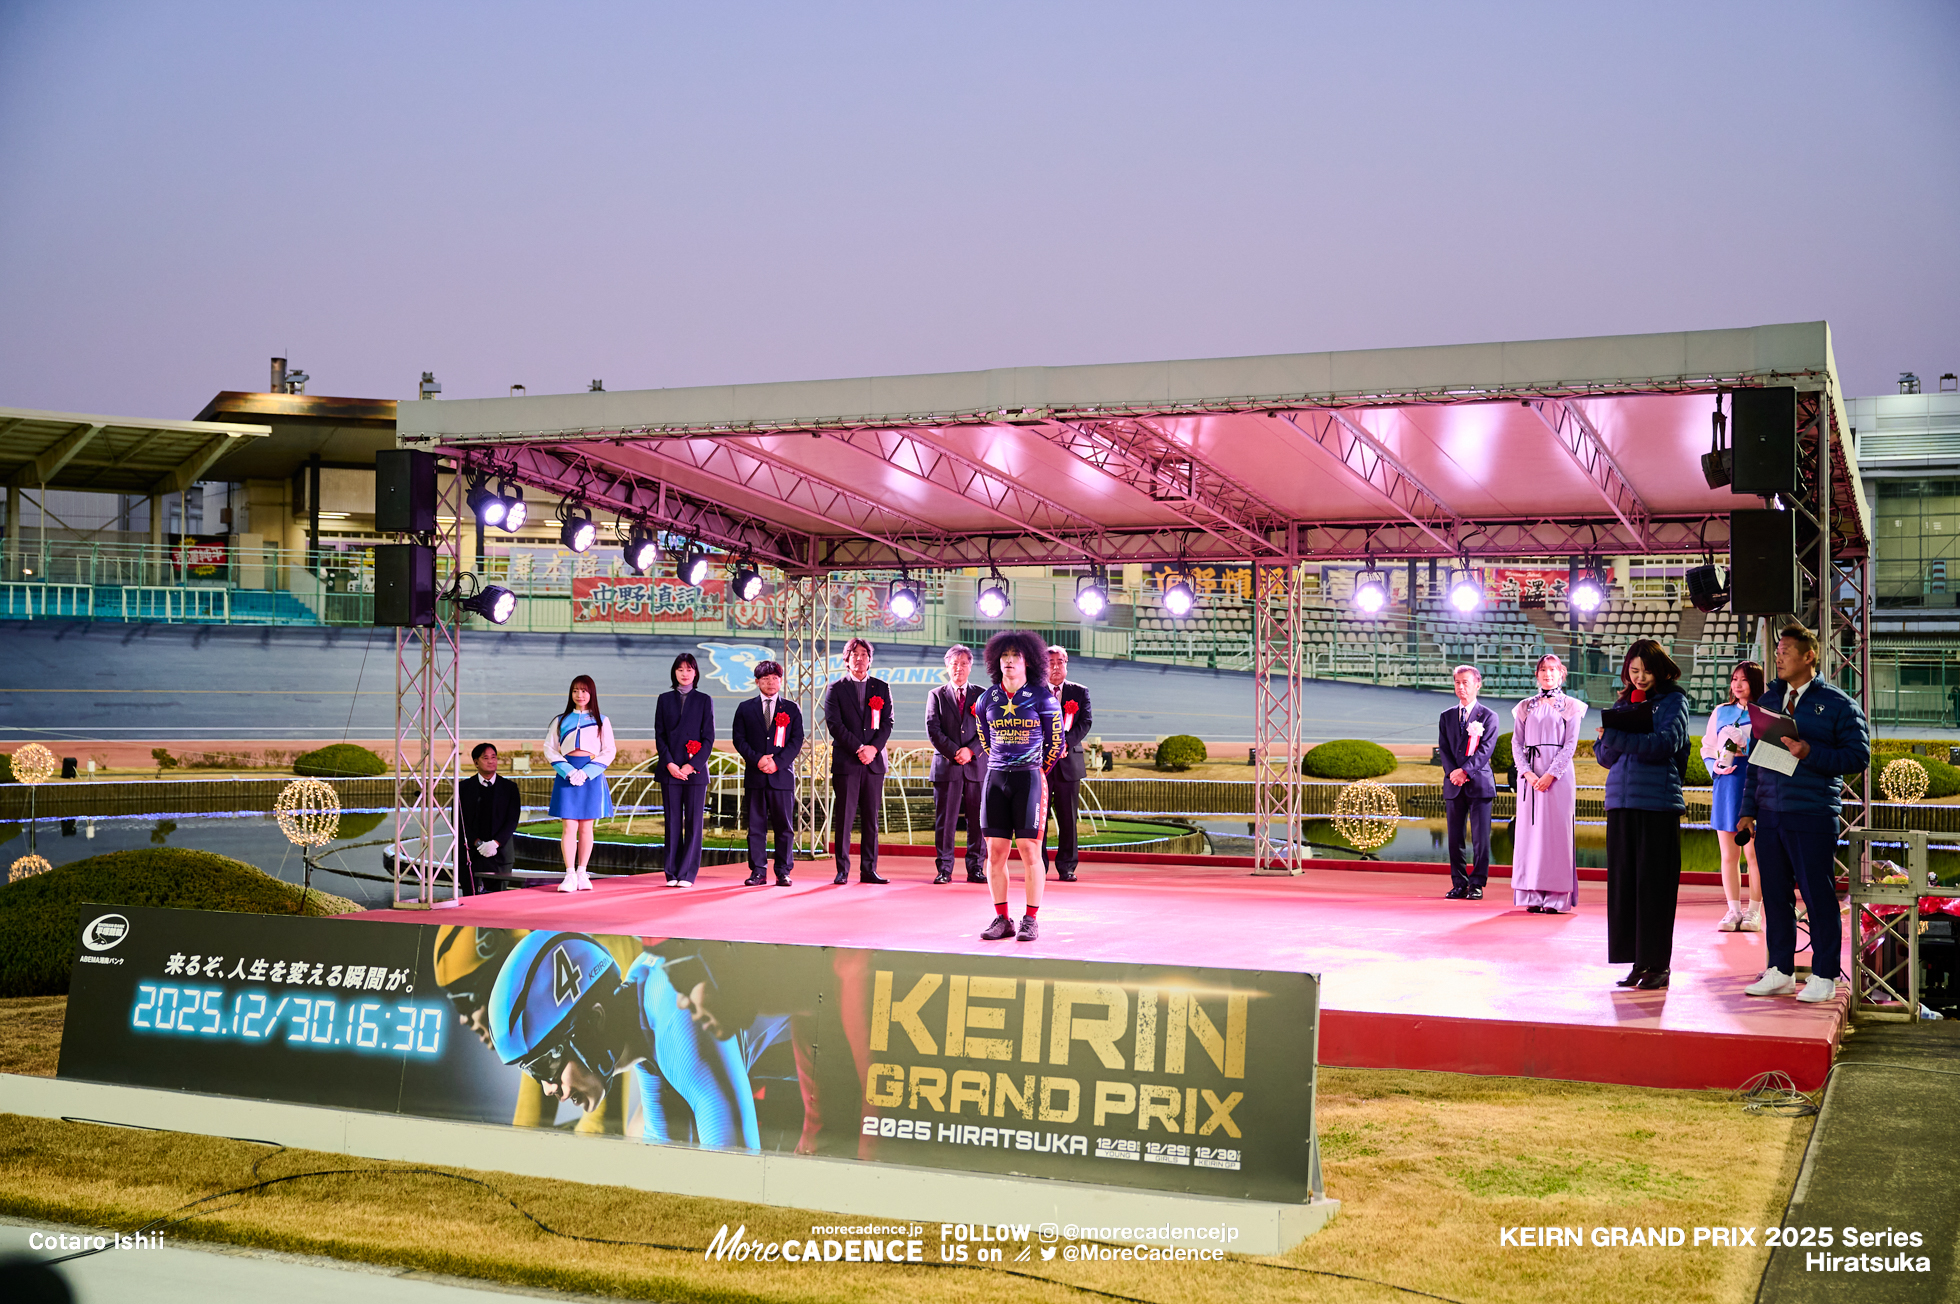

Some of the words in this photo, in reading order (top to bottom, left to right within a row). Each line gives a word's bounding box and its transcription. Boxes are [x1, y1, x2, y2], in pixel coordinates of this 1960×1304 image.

[591, 583, 704, 615] 中野慎詞
[164, 952, 413, 993] 来るぞ、人生を変える瞬間が。
[553, 945, 583, 1007] 4
[869, 970, 1248, 1079] KEIRIN
[866, 1063, 1081, 1124] GRAND
[1093, 1080, 1244, 1138] PRIX
[862, 1116, 932, 1141] 2025
[937, 1123, 1088, 1156] HIRATSUKA
[1096, 1137, 1137, 1152] 12/28
[1145, 1141, 1186, 1156] 12/29
[1195, 1146, 1237, 1161] 12/30
[1104, 1150, 1131, 1159] YOUNG
[1155, 1155, 1178, 1164] GIRLS
[1198, 1160, 1224, 1168] KEIRIN
